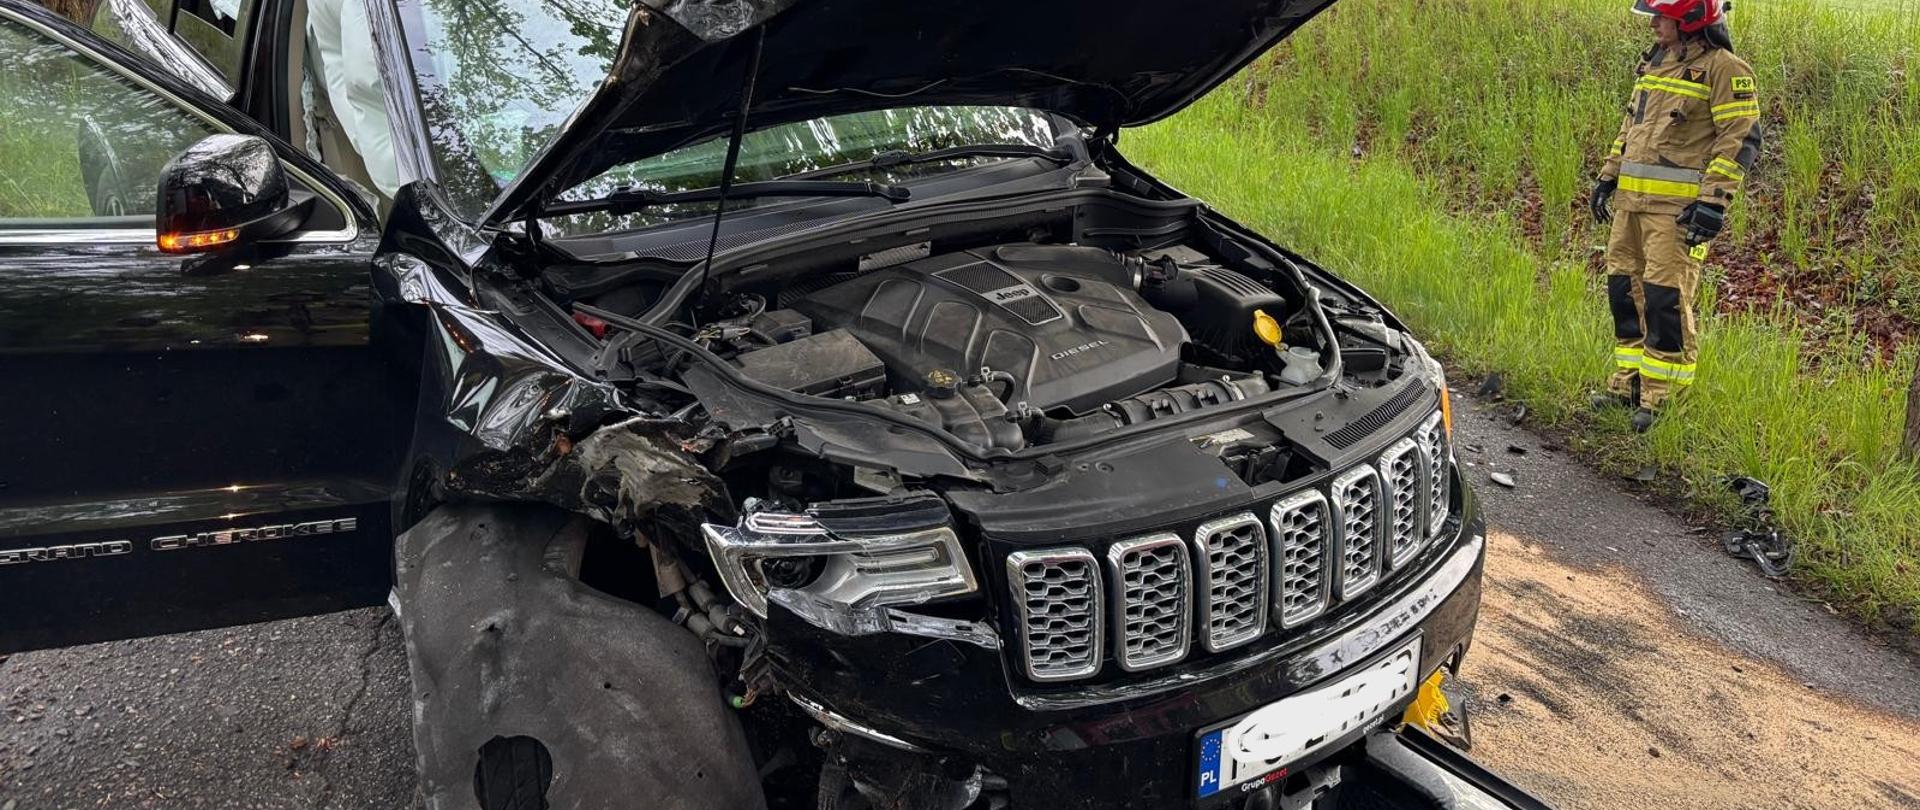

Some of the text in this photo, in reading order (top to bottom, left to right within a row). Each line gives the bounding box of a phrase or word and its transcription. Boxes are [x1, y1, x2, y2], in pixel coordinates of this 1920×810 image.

[996, 287, 1030, 301] Jeep
[1051, 339, 1110, 361] DIESEL
[151, 517, 357, 551] CHEROKEE
[1200, 769, 1217, 787] PL
